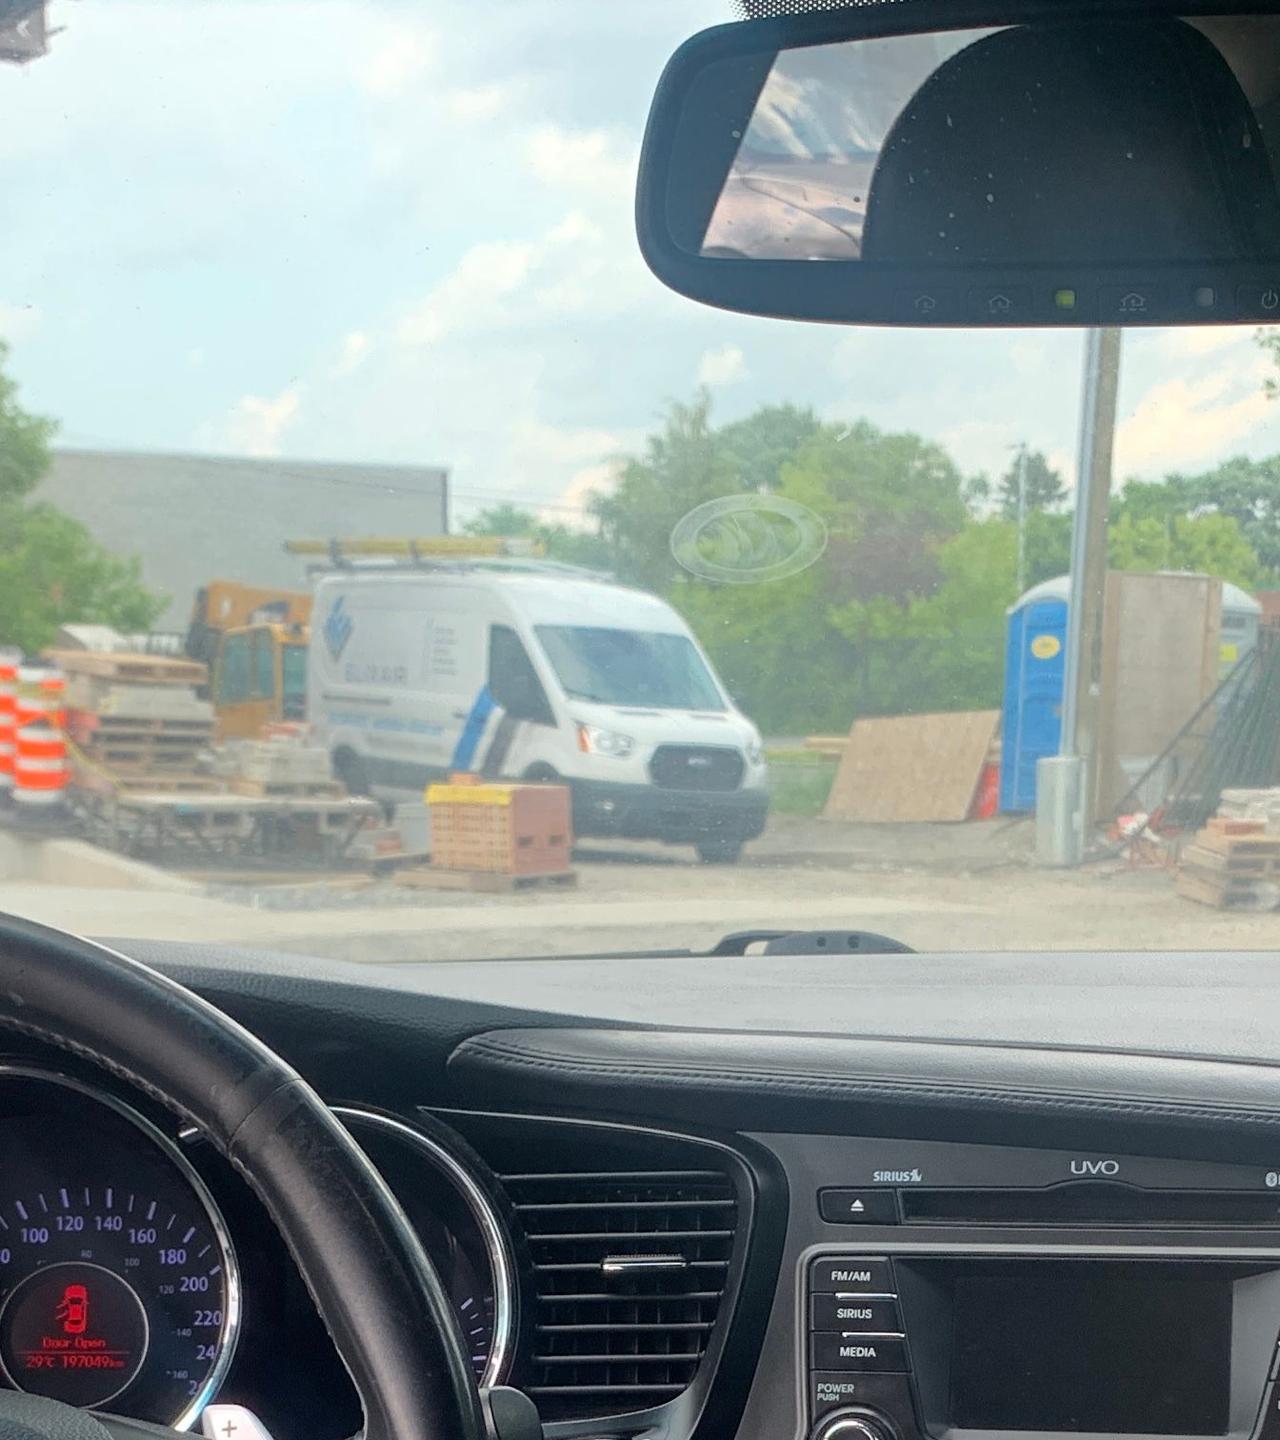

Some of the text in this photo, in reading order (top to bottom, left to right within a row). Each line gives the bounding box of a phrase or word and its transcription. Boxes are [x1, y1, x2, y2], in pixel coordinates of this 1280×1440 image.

[1070, 1160, 1119, 1175] UVO
[56, 1216, 84, 1231] 120
[95, 1216, 123, 1231] 140
[21, 1228, 49, 1243] 100
[129, 1229, 156, 1244] 160
[158, 1250, 186, 1265] 180
[831, 1270, 871, 1282] FM/AM
[180, 1277, 208, 1291] 200
[194, 1310, 222, 1325] 220
[836, 1308, 872, 1320] SIRIUS
[75, 1337, 106, 1349] Open
[196, 1345, 216, 1360] 24
[839, 1346, 876, 1358] MEDIA
[817, 1383, 855, 1394] POWER
[817, 1392, 840, 1401] PUSH
